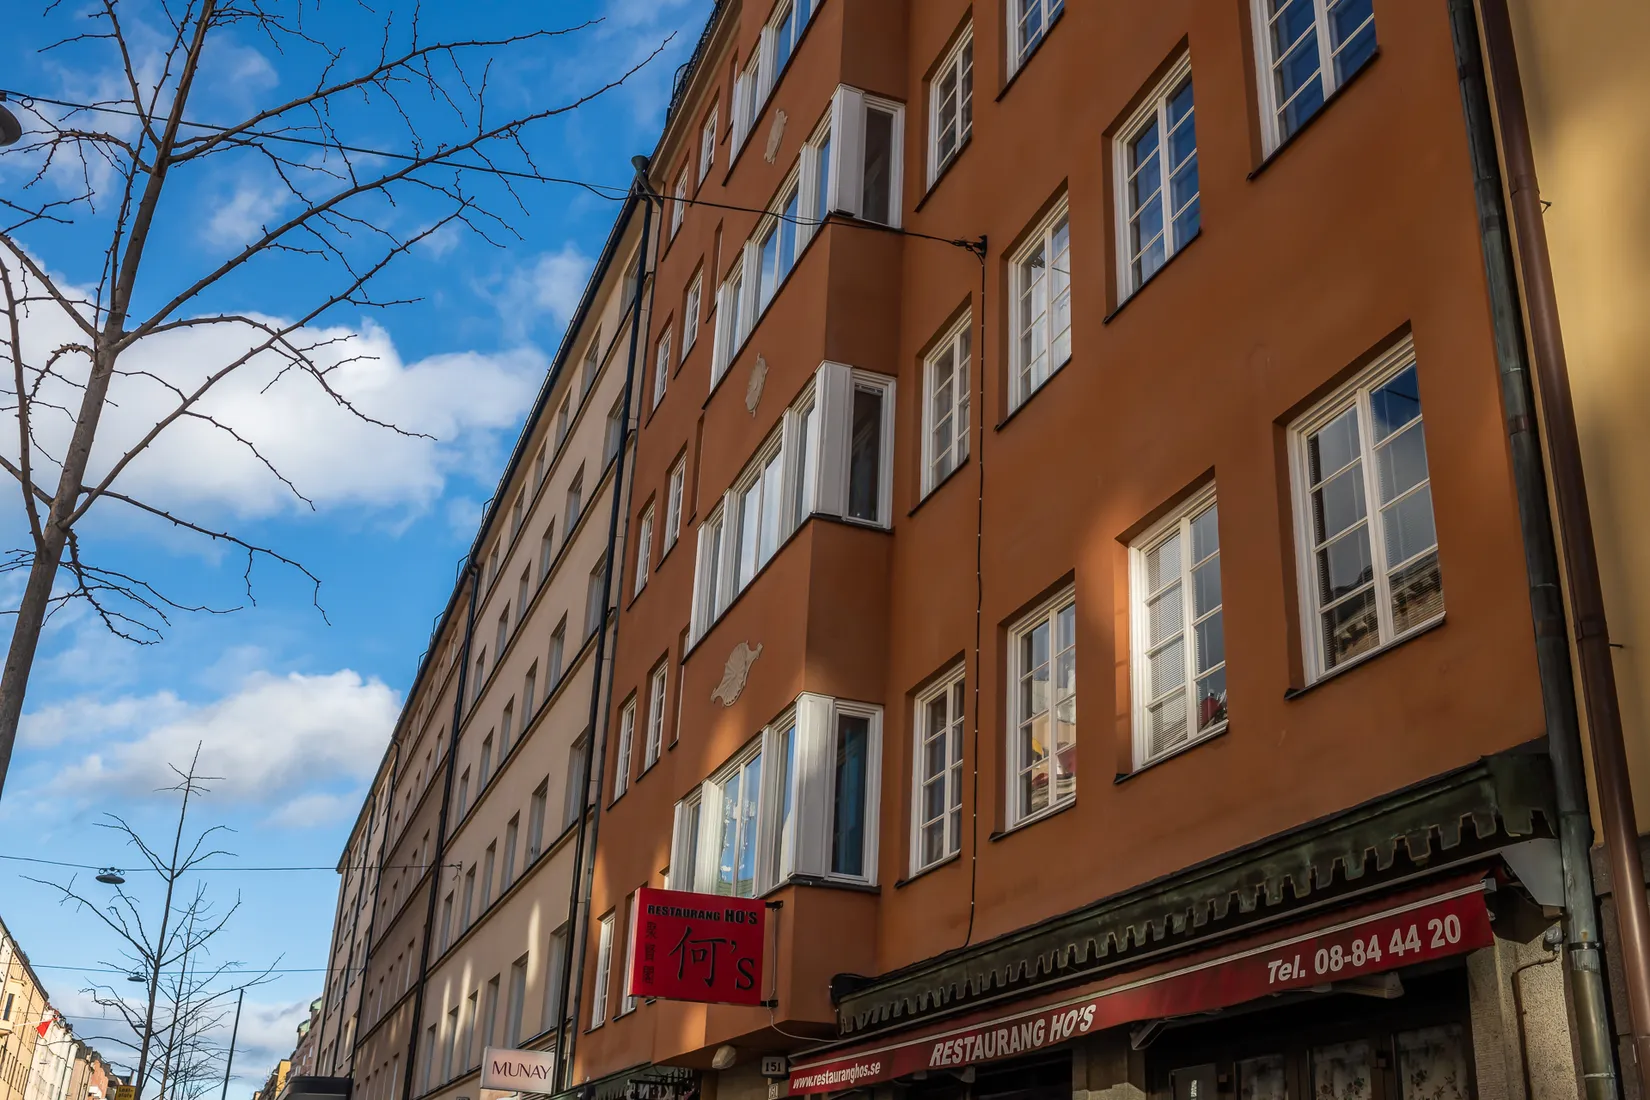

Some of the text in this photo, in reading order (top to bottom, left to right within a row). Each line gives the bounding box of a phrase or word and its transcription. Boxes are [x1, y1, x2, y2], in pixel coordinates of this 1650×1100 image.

[647, 904, 758, 925] RESTAURANG HO'S
[1267, 914, 1461, 984] Tel. 08-84 44 20
[929, 1004, 1097, 1067] RESTAURANG HO'S
[492, 1060, 552, 1080] MUNAY
[765, 1062, 781, 1072] 151
[792, 1061, 881, 1090] www.restauranghos.se
